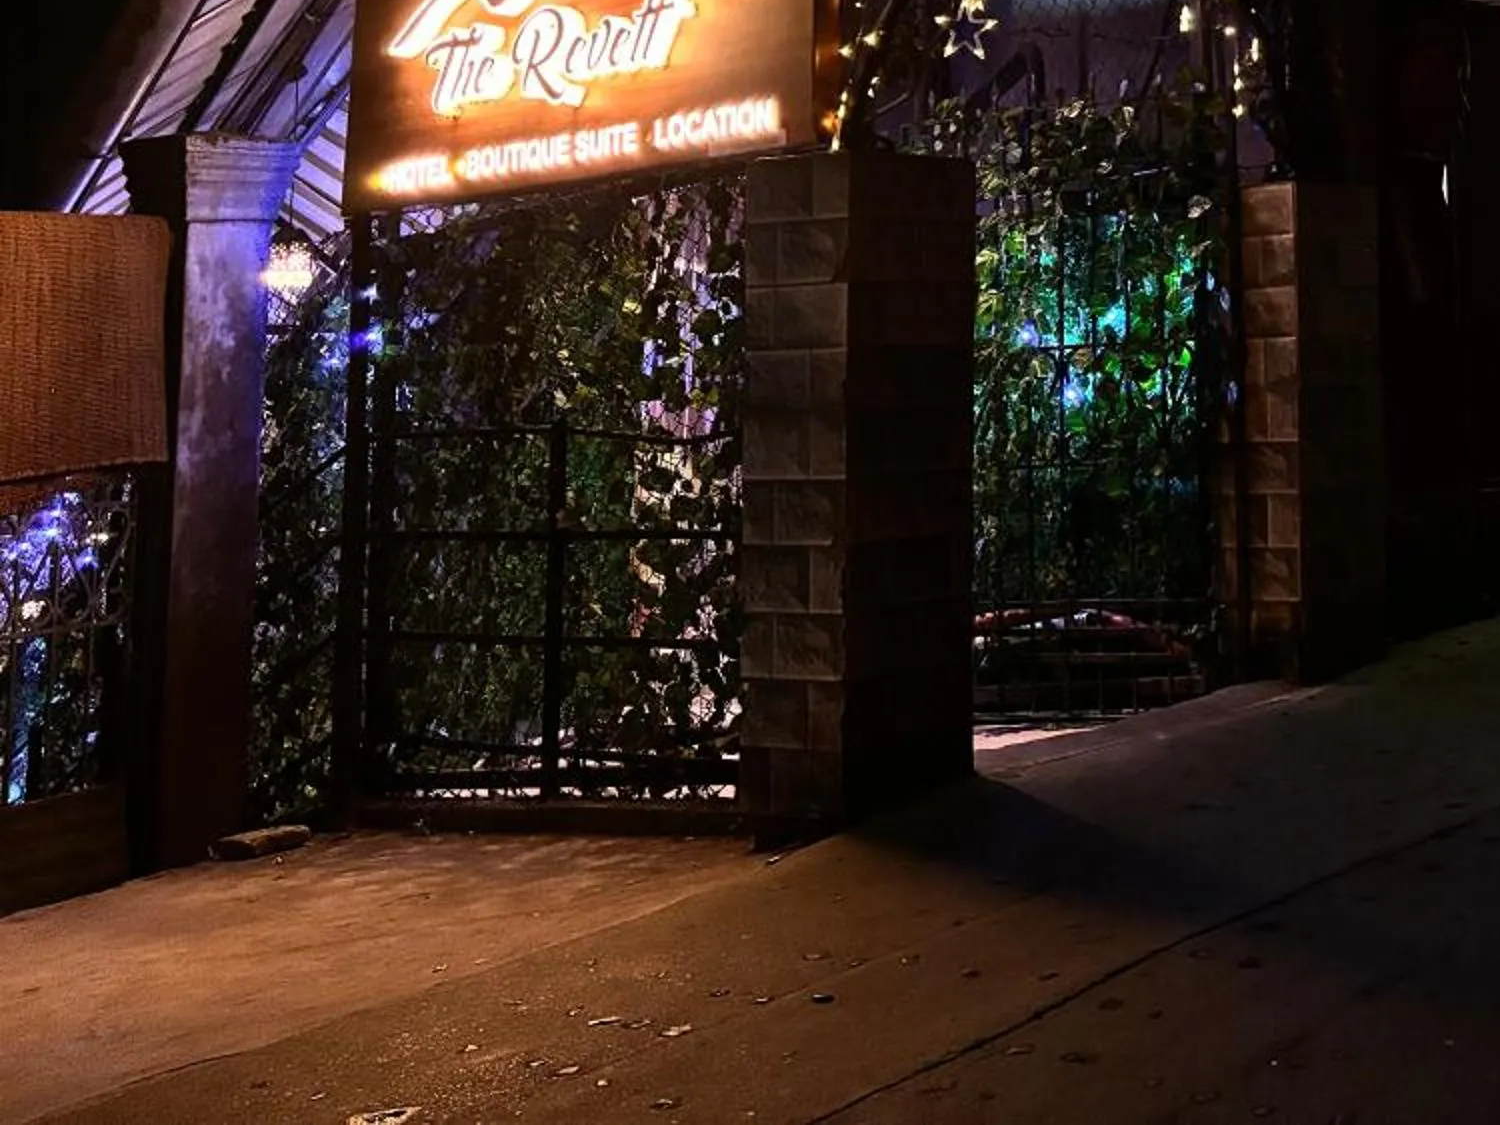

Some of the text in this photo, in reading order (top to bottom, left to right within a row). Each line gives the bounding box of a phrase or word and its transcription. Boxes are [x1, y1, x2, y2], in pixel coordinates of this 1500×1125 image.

[425, 26, 502, 112] The
[466, 135, 570, 179] BOUTIQUE
[575, 124, 638, 161] SUITE
[652, 98, 775, 150] LOCATION
